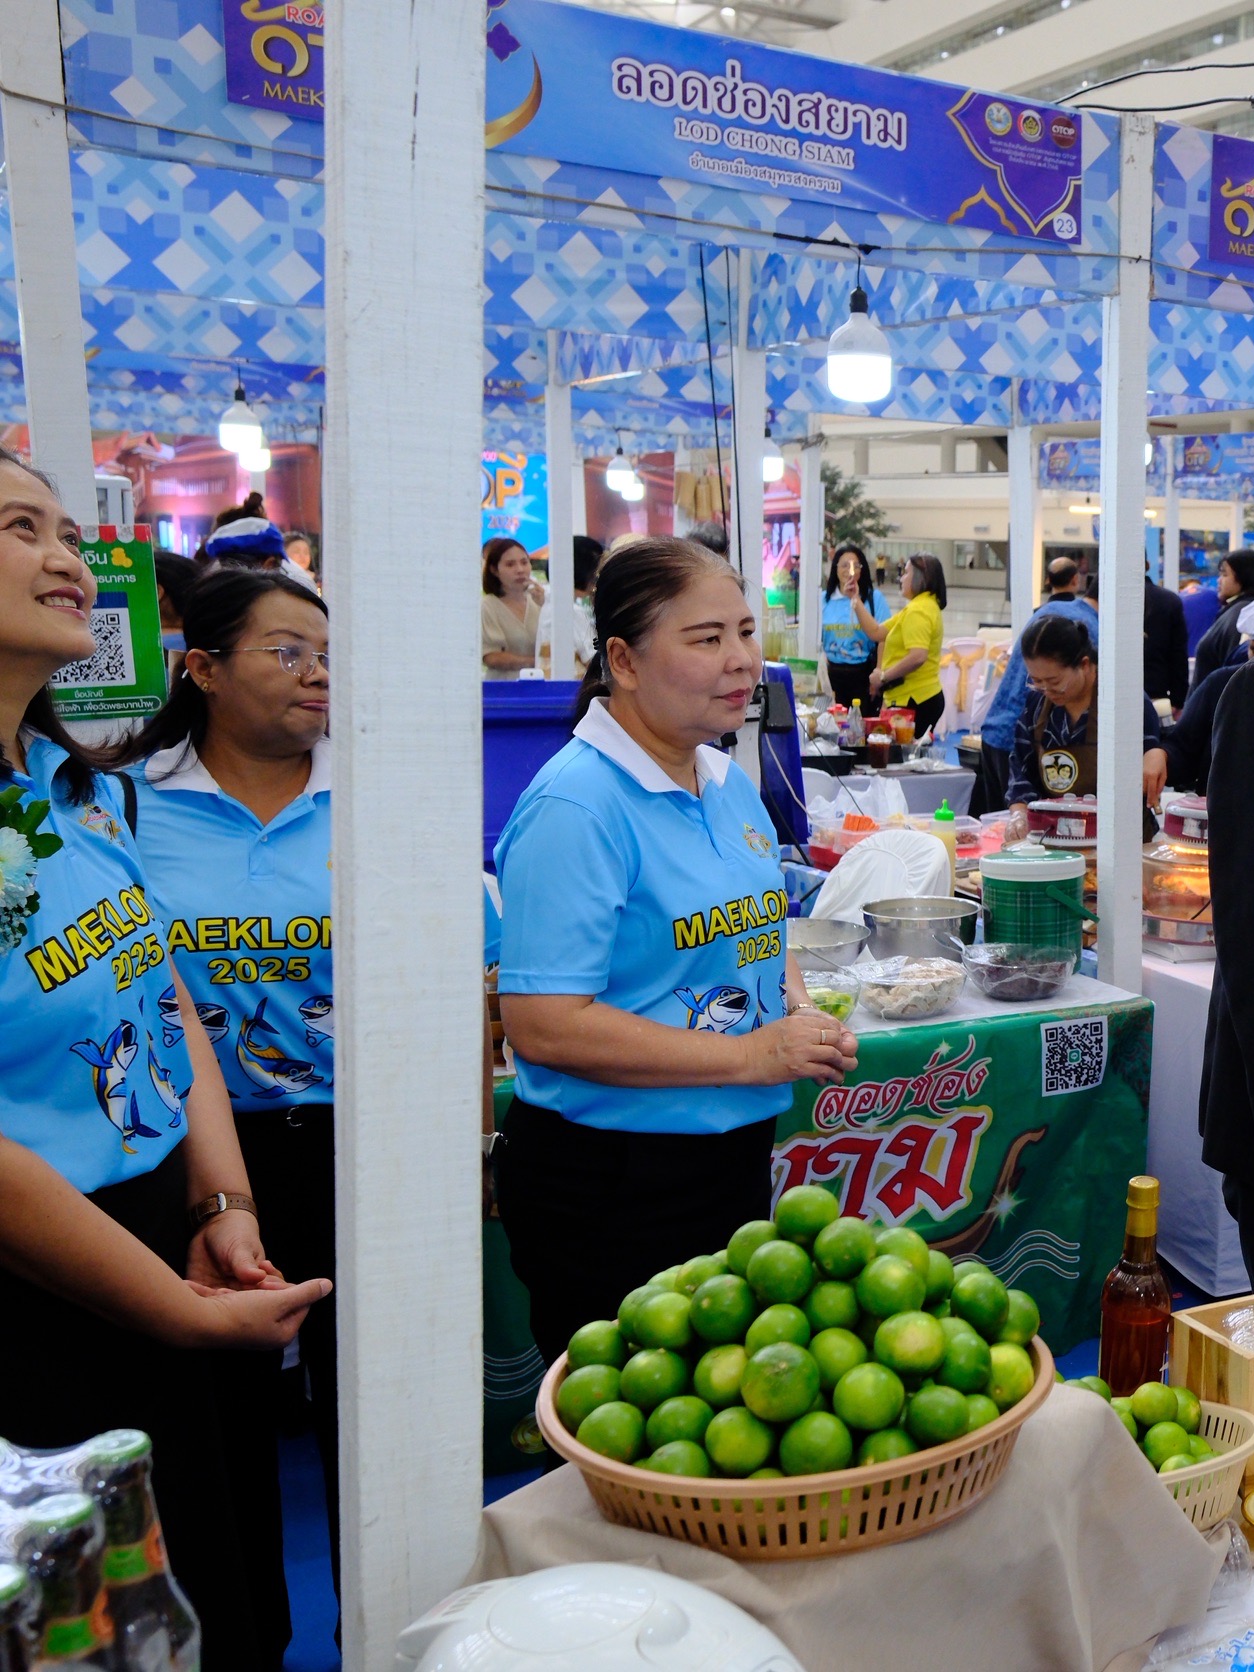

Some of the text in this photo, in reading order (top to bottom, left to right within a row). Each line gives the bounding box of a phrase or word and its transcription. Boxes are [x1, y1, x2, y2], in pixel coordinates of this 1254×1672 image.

[612, 57, 907, 151] ลอดช่องสยาม
[675, 117, 854, 169] LOD CHONG SIAM
[1052, 124, 1075, 136] OTOP
[689, 152, 842, 193] อำเภอเมืองสมุทรสงคราม
[1056, 218, 1075, 234] 23
[737, 930, 781, 969] 2025
[208, 957, 310, 984] 2025
[813, 1034, 992, 1129] ลอดช่อง
